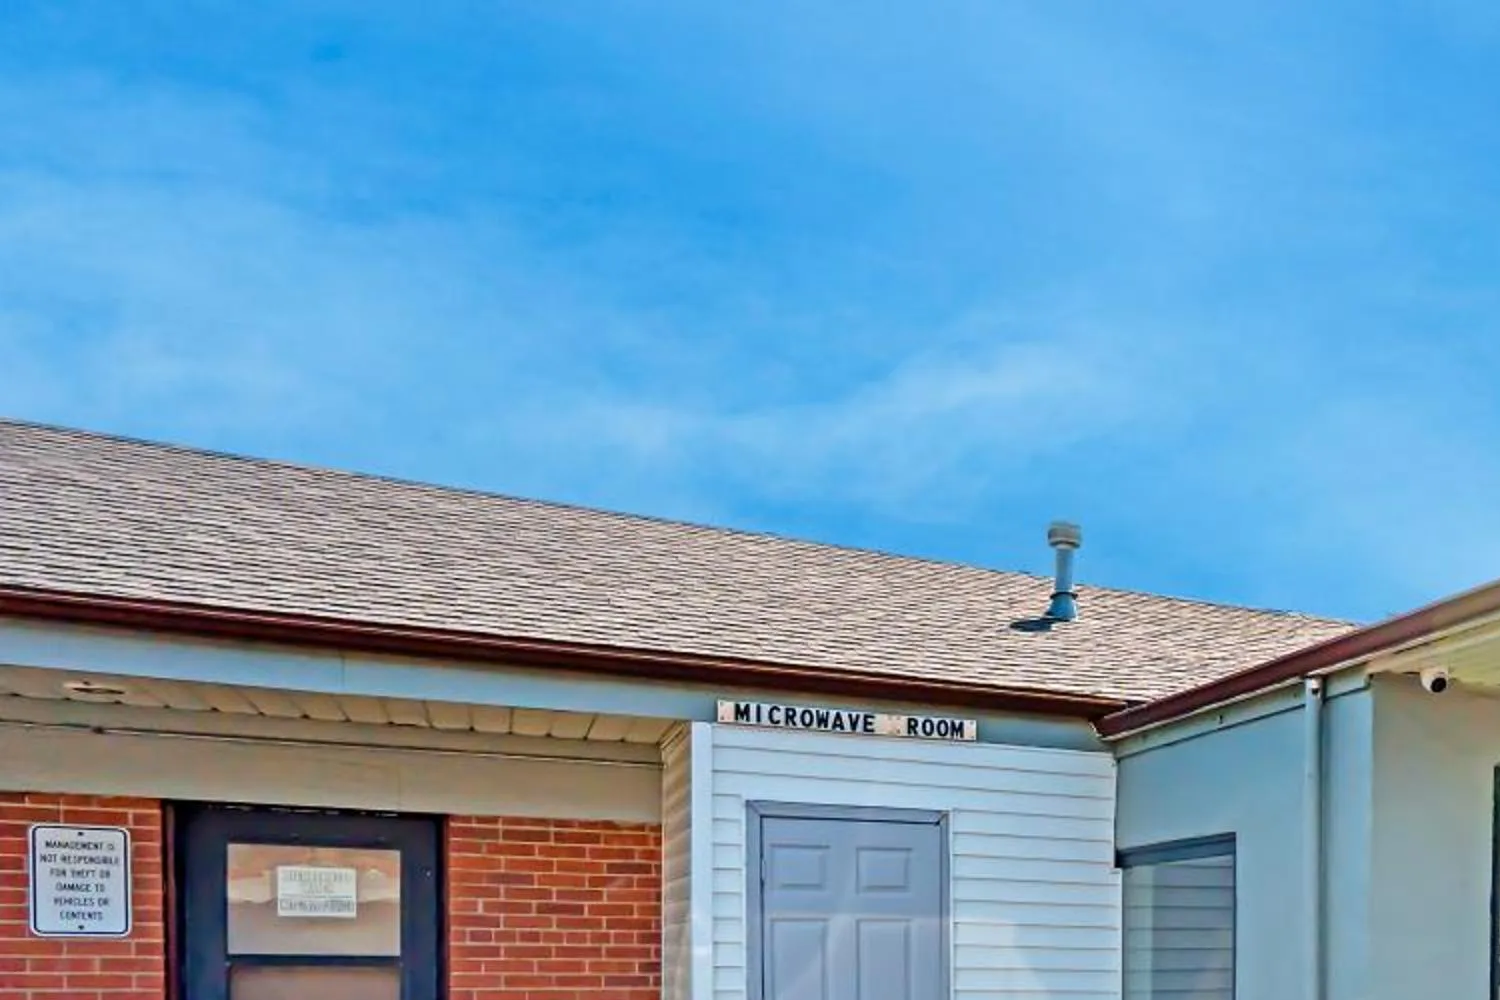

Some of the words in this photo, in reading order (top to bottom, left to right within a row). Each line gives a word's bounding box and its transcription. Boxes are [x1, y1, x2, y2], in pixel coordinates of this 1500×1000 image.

[734, 703, 876, 733] MICROWAVE
[907, 717, 965, 738] ROOM
[45, 840, 103, 850] MANAGEMENT
[40, 853, 57, 863] NOT
[60, 854, 120, 865] RESPONSIBLE
[50, 868, 66, 878] FOR
[70, 869, 96, 879] THEFT
[99, 870, 111, 879] OR
[56, 882, 92, 892] DAMAGE
[96, 884, 105, 893] TO
[53, 897, 94, 907] VEHICLES
[98, 897, 109, 907] OR
[59, 910, 103, 921] CONTENTS
